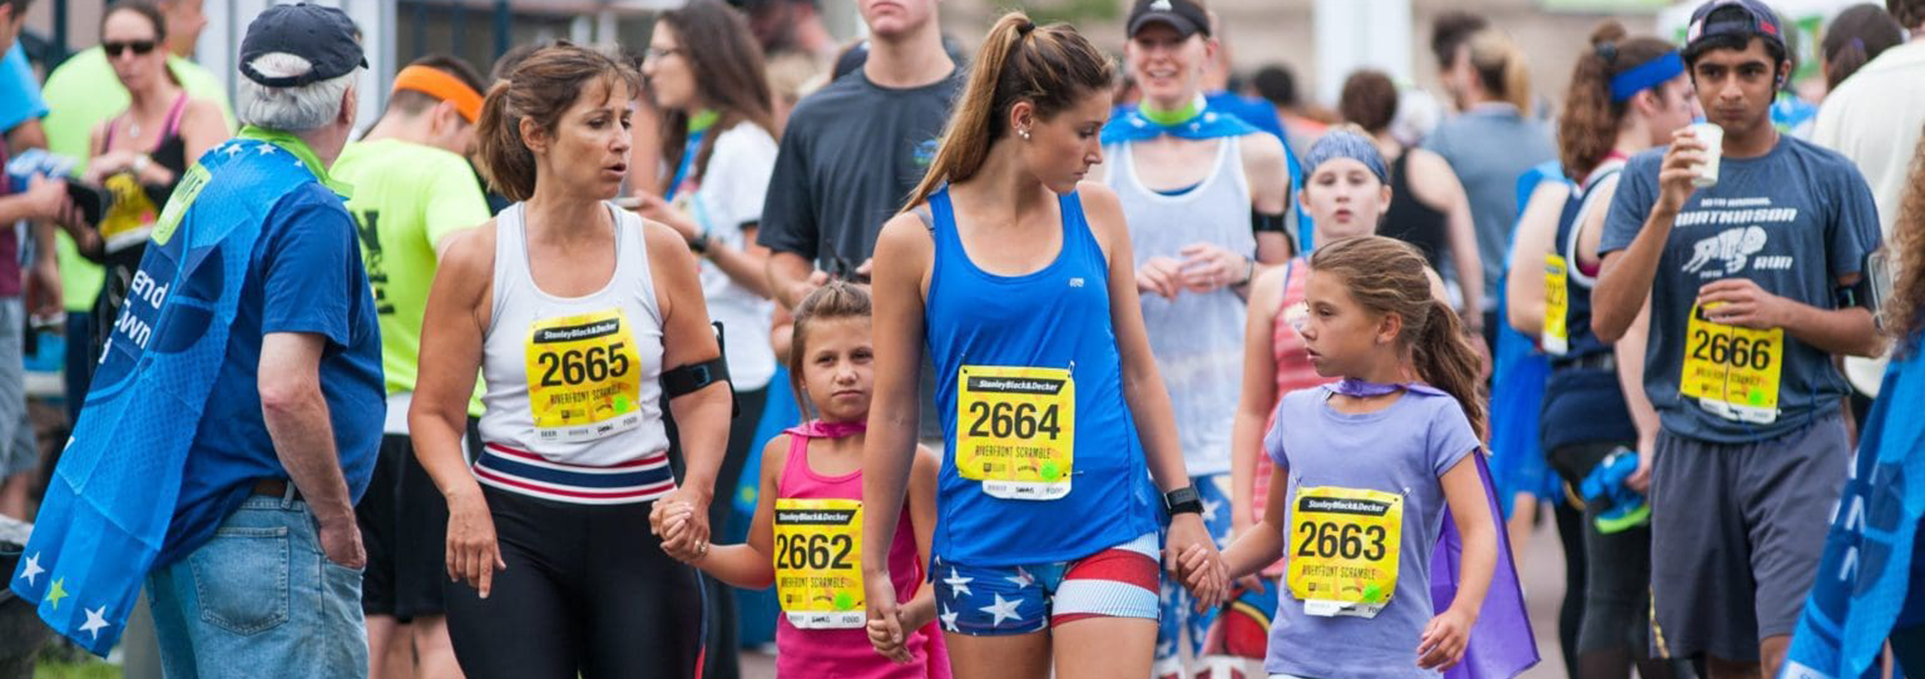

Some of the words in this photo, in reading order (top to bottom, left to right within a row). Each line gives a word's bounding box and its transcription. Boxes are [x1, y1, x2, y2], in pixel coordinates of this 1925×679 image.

[1753, 256, 1793, 270] RUN
[538, 342, 629, 387] 2665
[1692, 328, 1771, 371] 2666
[968, 401, 1061, 440] 2664
[975, 445, 1014, 457] RIVERFRONT
[1016, 446, 1051, 459] SCRAMBLE
[776, 533, 853, 570] 2662
[1297, 520, 1386, 562] 2663
[811, 577, 845, 588] SCRAMBLE
[1302, 565, 1339, 577] RIVERFRONT
[1340, 566, 1377, 580] SCRAMBLE
